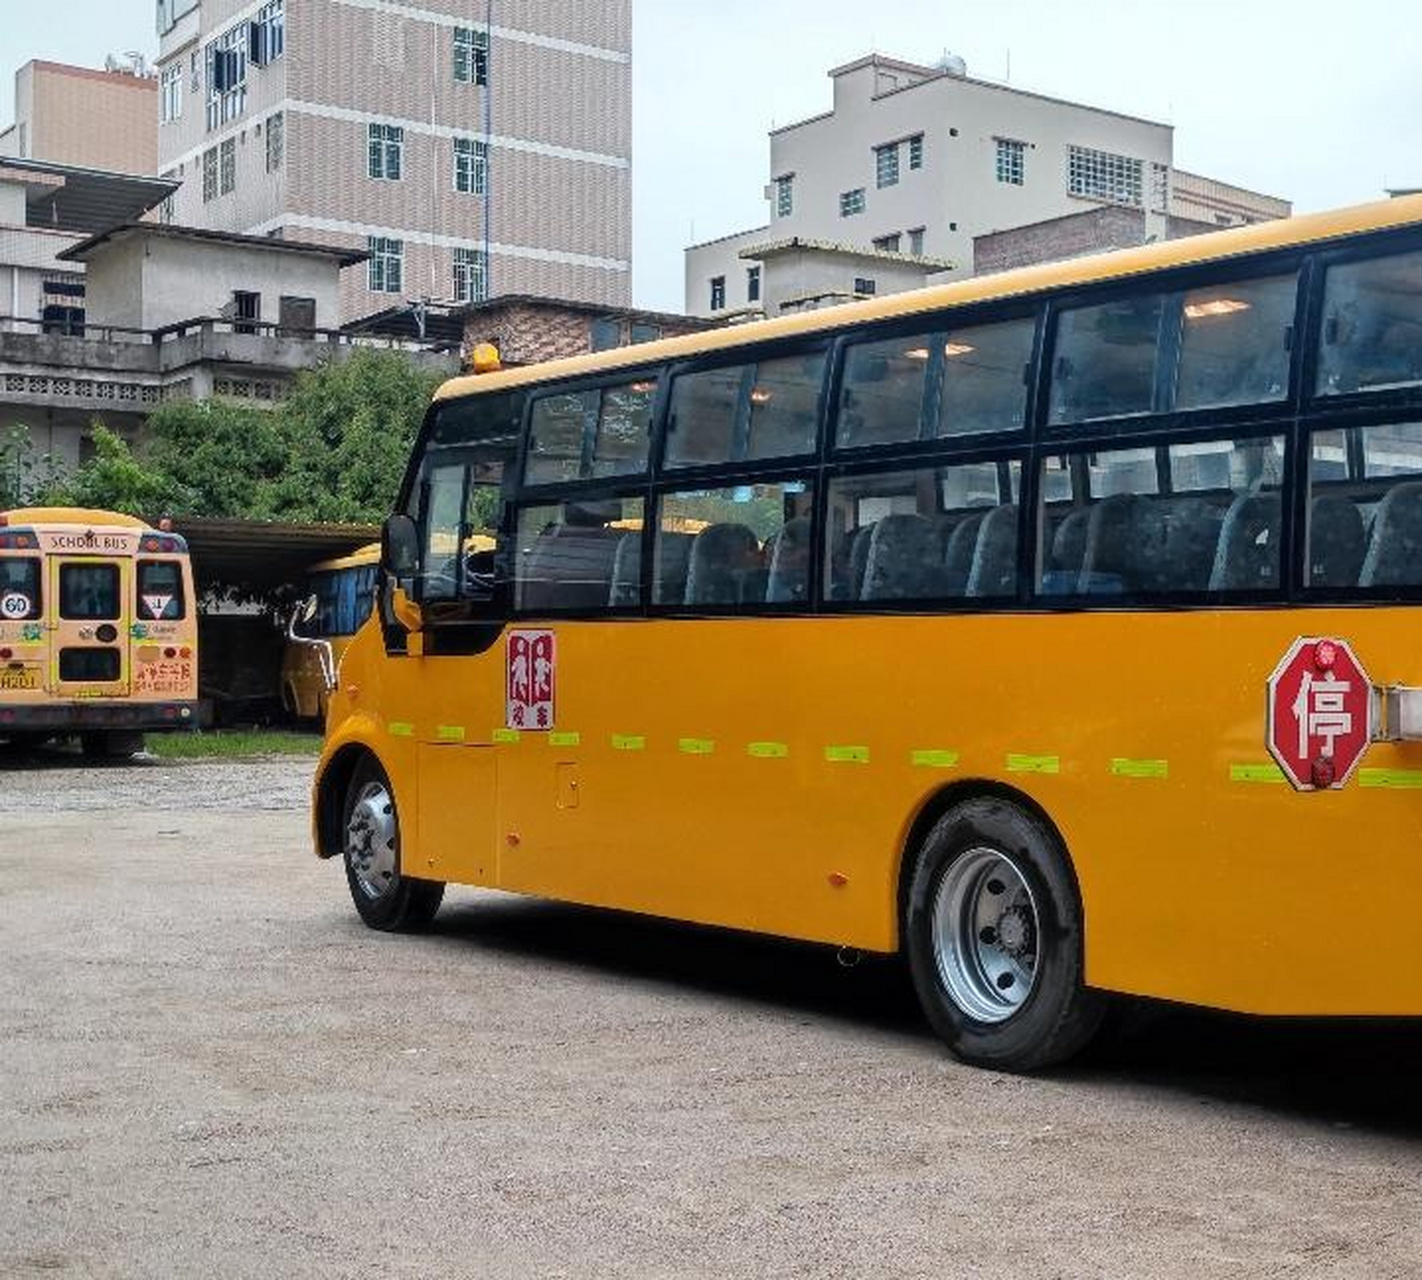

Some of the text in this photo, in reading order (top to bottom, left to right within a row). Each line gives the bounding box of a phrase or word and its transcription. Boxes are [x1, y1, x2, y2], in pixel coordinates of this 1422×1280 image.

[51, 536, 128, 550] SCHOOL BUS
[5, 599, 27, 613] 60
[1291, 669, 1352, 760] 停
